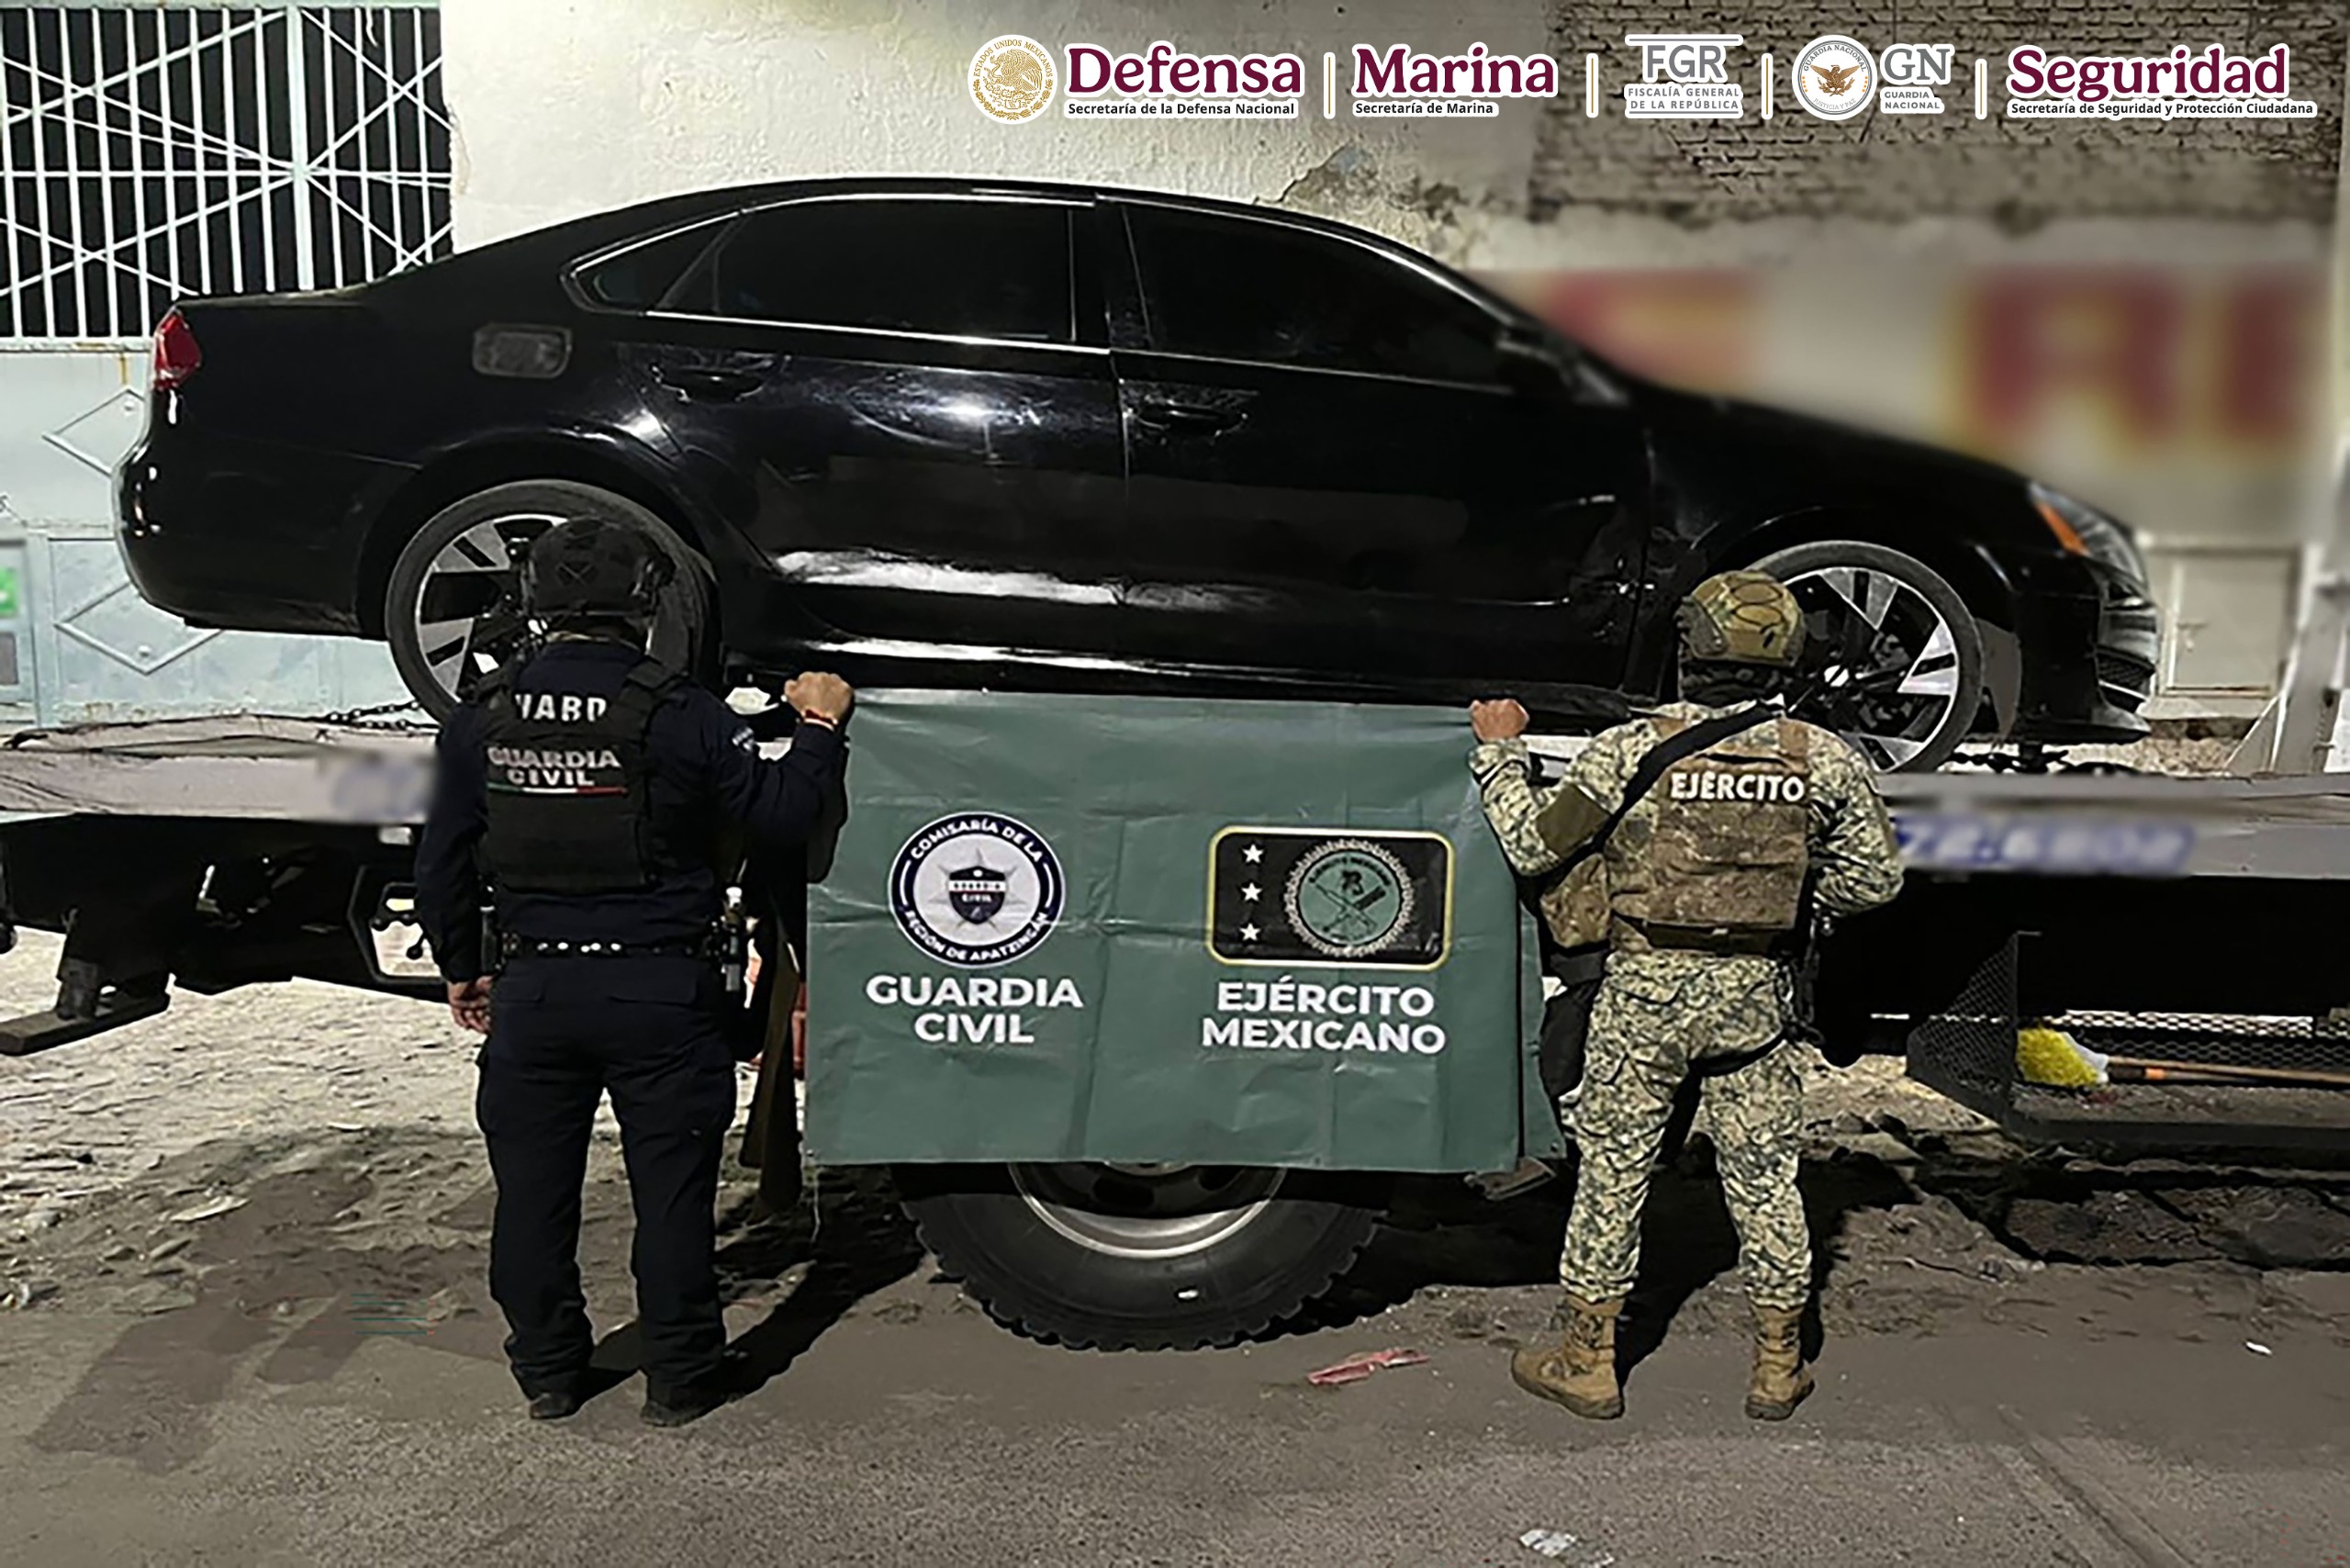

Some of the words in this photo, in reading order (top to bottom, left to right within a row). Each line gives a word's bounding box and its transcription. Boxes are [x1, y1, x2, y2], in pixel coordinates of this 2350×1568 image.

[487, 746, 621, 768] GUARDIA
[507, 769, 595, 786] CIVIL
[1002, 826, 1026, 845] DE
[1024, 842, 1043, 862] LA
[946, 946, 968, 960] DE
[866, 974, 1084, 1007] GUARDIA
[1218, 975, 1435, 1016] EJÉRCITO
[914, 1013, 1035, 1043] CIVIL
[1203, 1016, 1447, 1054] MEXICANO
